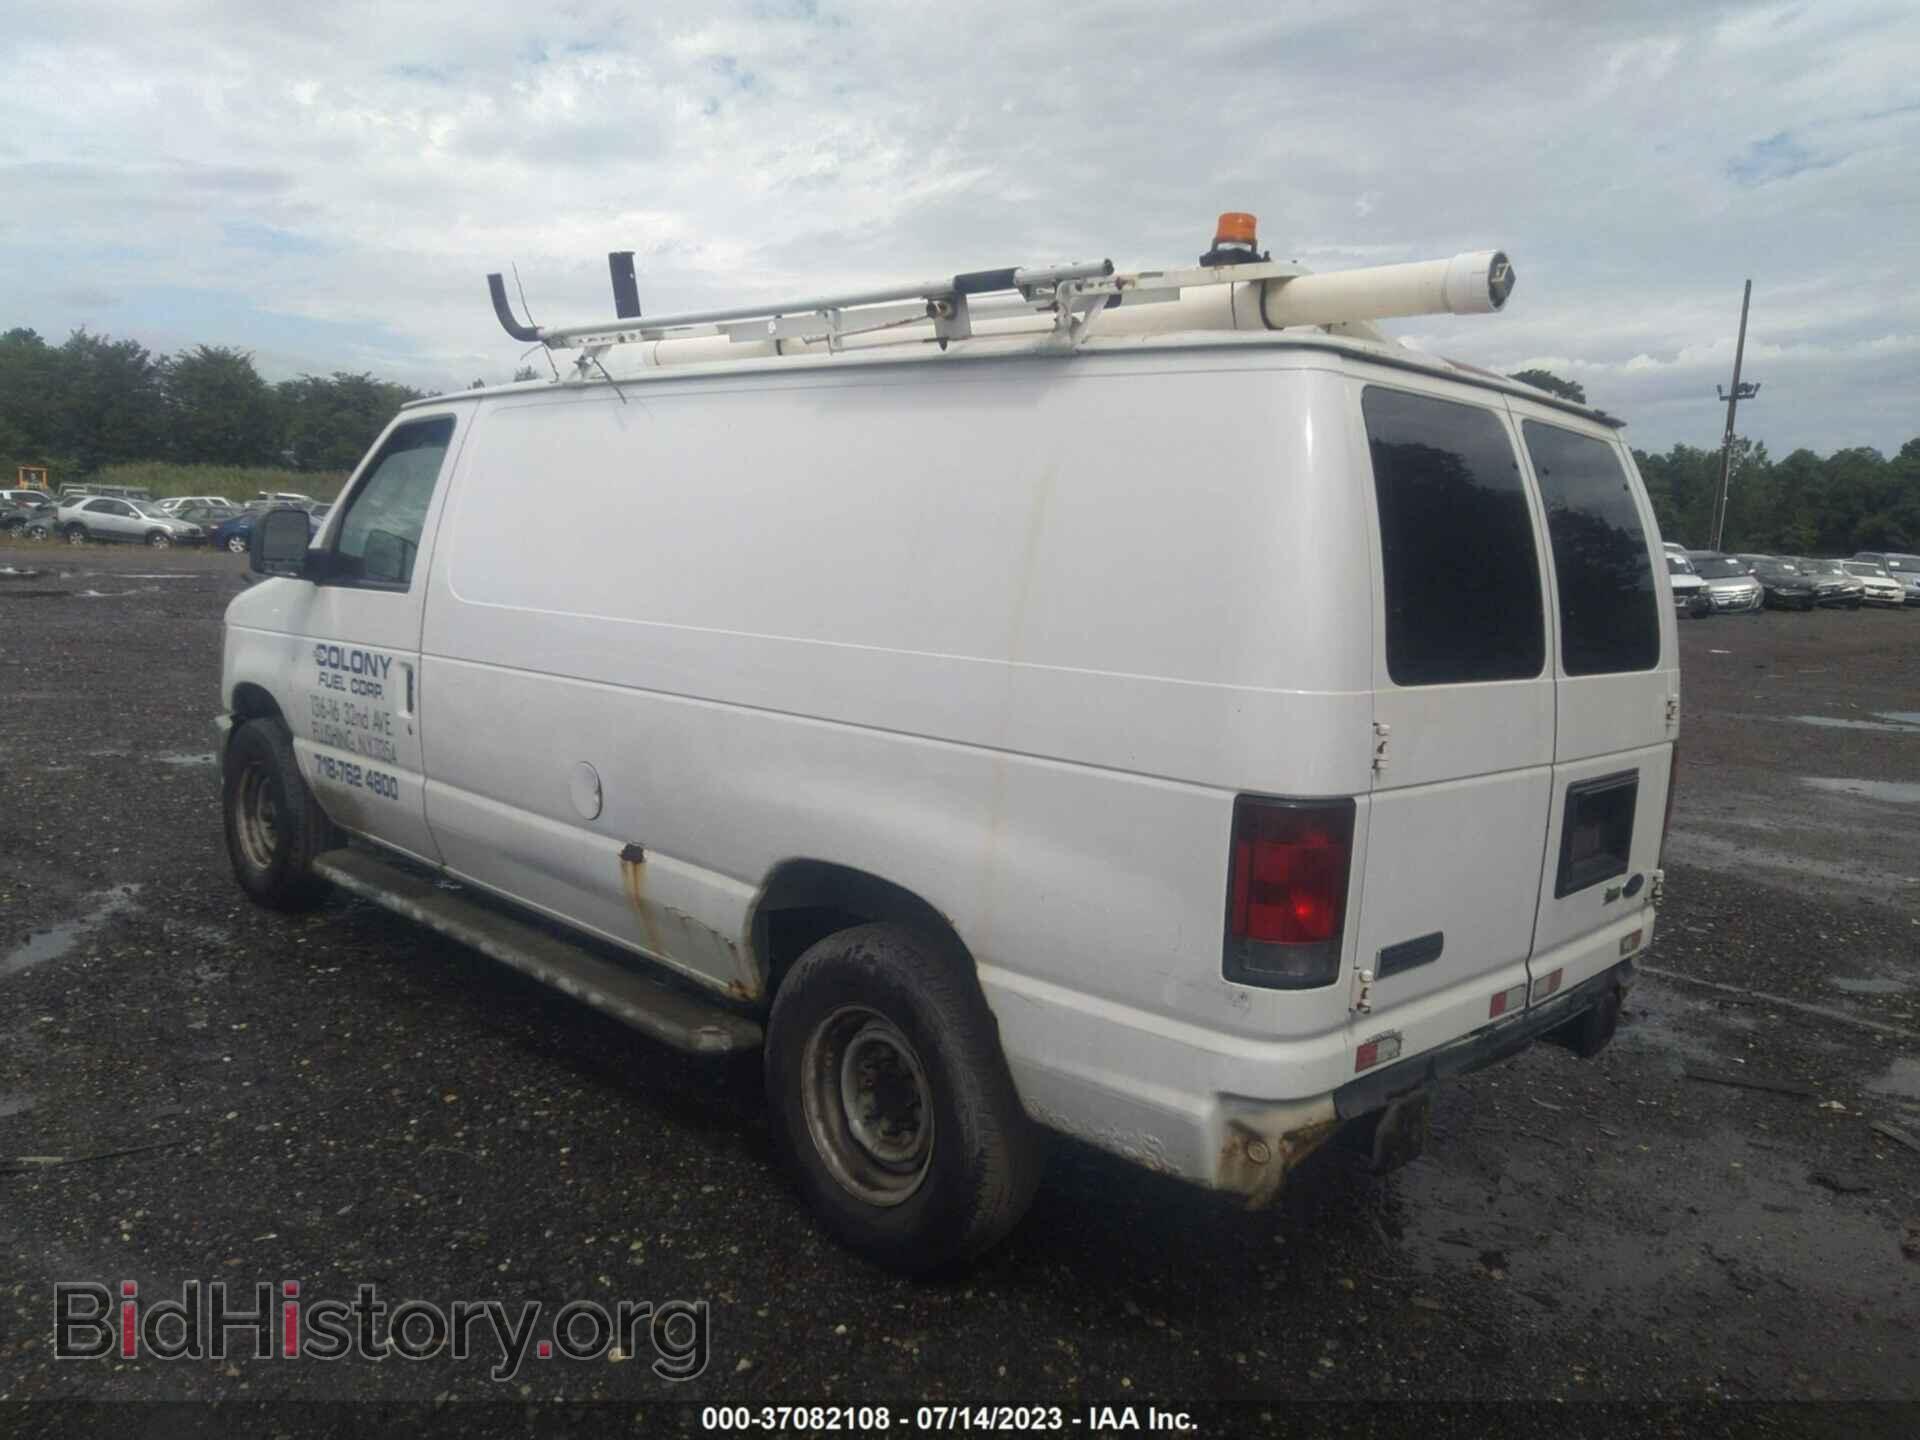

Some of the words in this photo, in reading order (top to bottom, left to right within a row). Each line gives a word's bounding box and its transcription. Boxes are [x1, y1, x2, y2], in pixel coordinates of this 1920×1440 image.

[315, 644, 392, 679] COLONY
[318, 671, 346, 692] FUEL
[350, 678, 384, 700] CORP.
